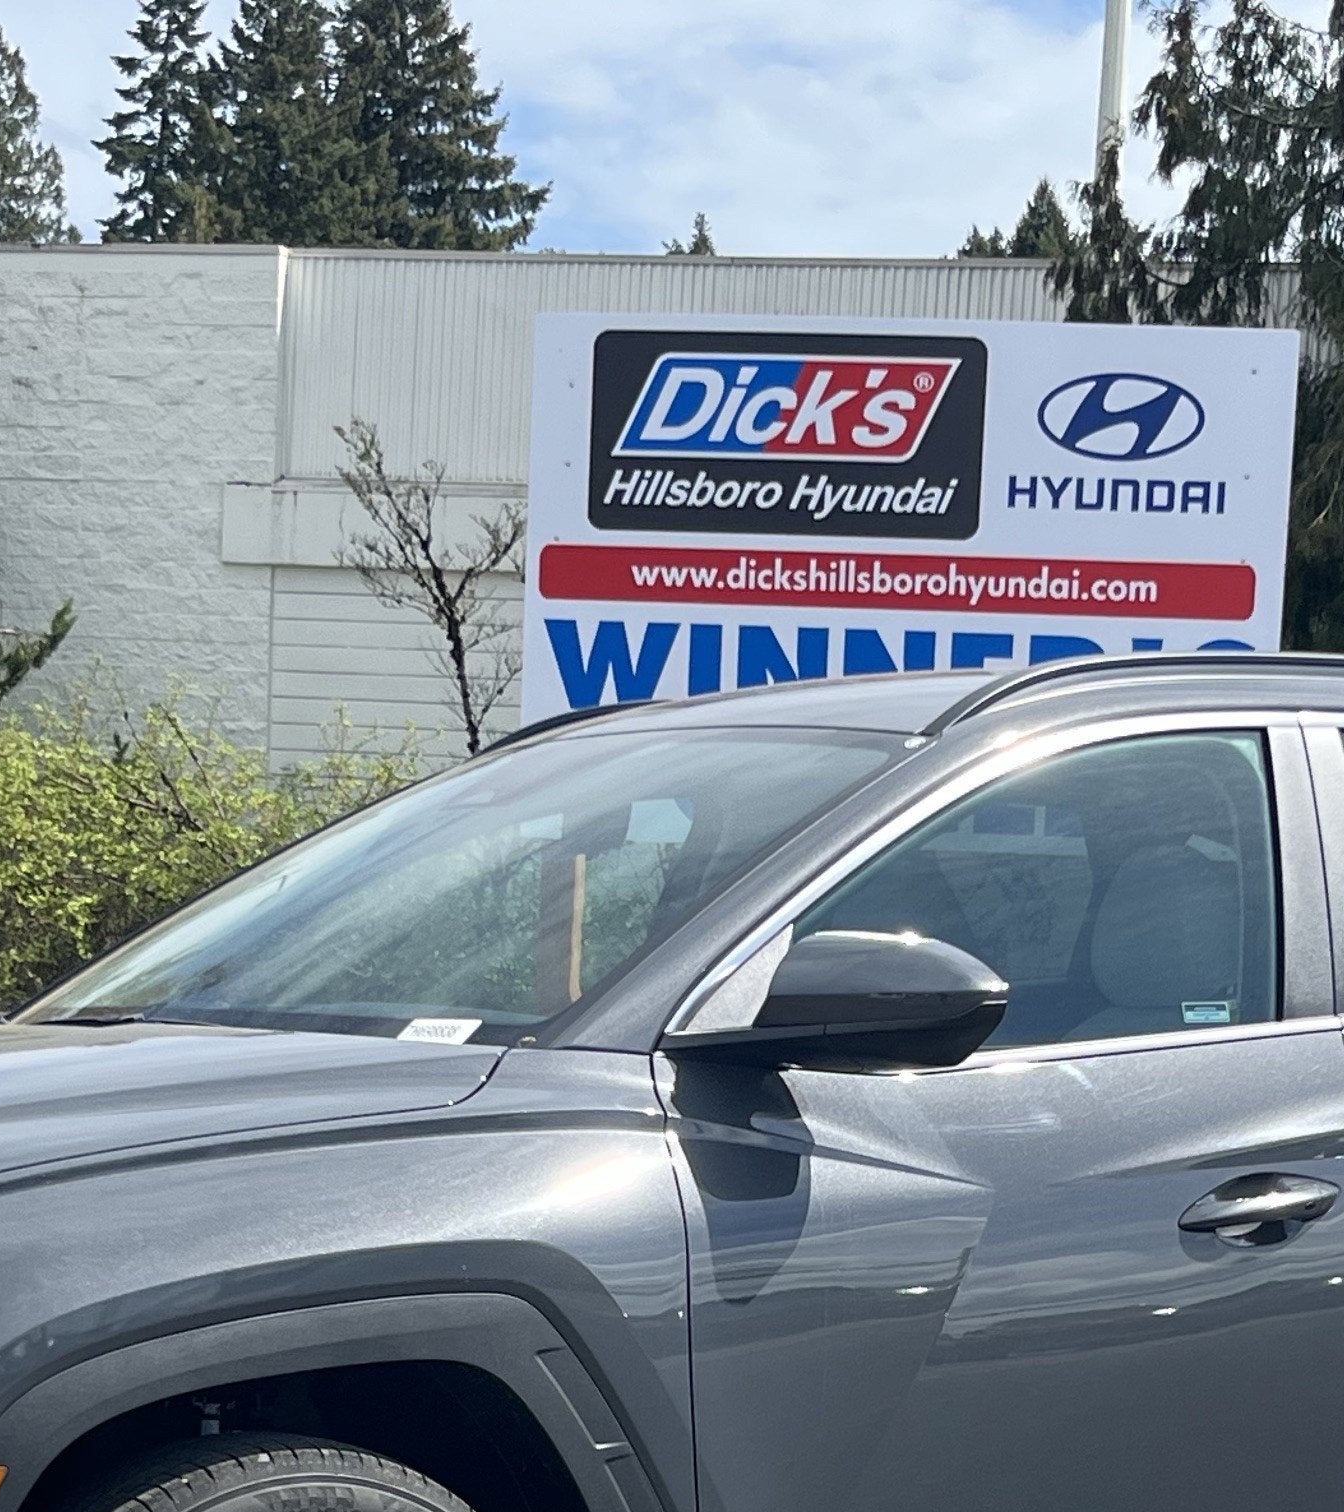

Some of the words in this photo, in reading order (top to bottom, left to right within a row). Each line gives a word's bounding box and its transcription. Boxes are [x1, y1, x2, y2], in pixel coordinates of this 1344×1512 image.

[640, 366, 916, 447] Dick's
[603, 469, 783, 509] Hillsboro
[788, 474, 958, 521] Hyundai
[1007, 475, 1226, 514] HYUNDAI
[631, 556, 1157, 606] www.dickshillsborohyundai.com
